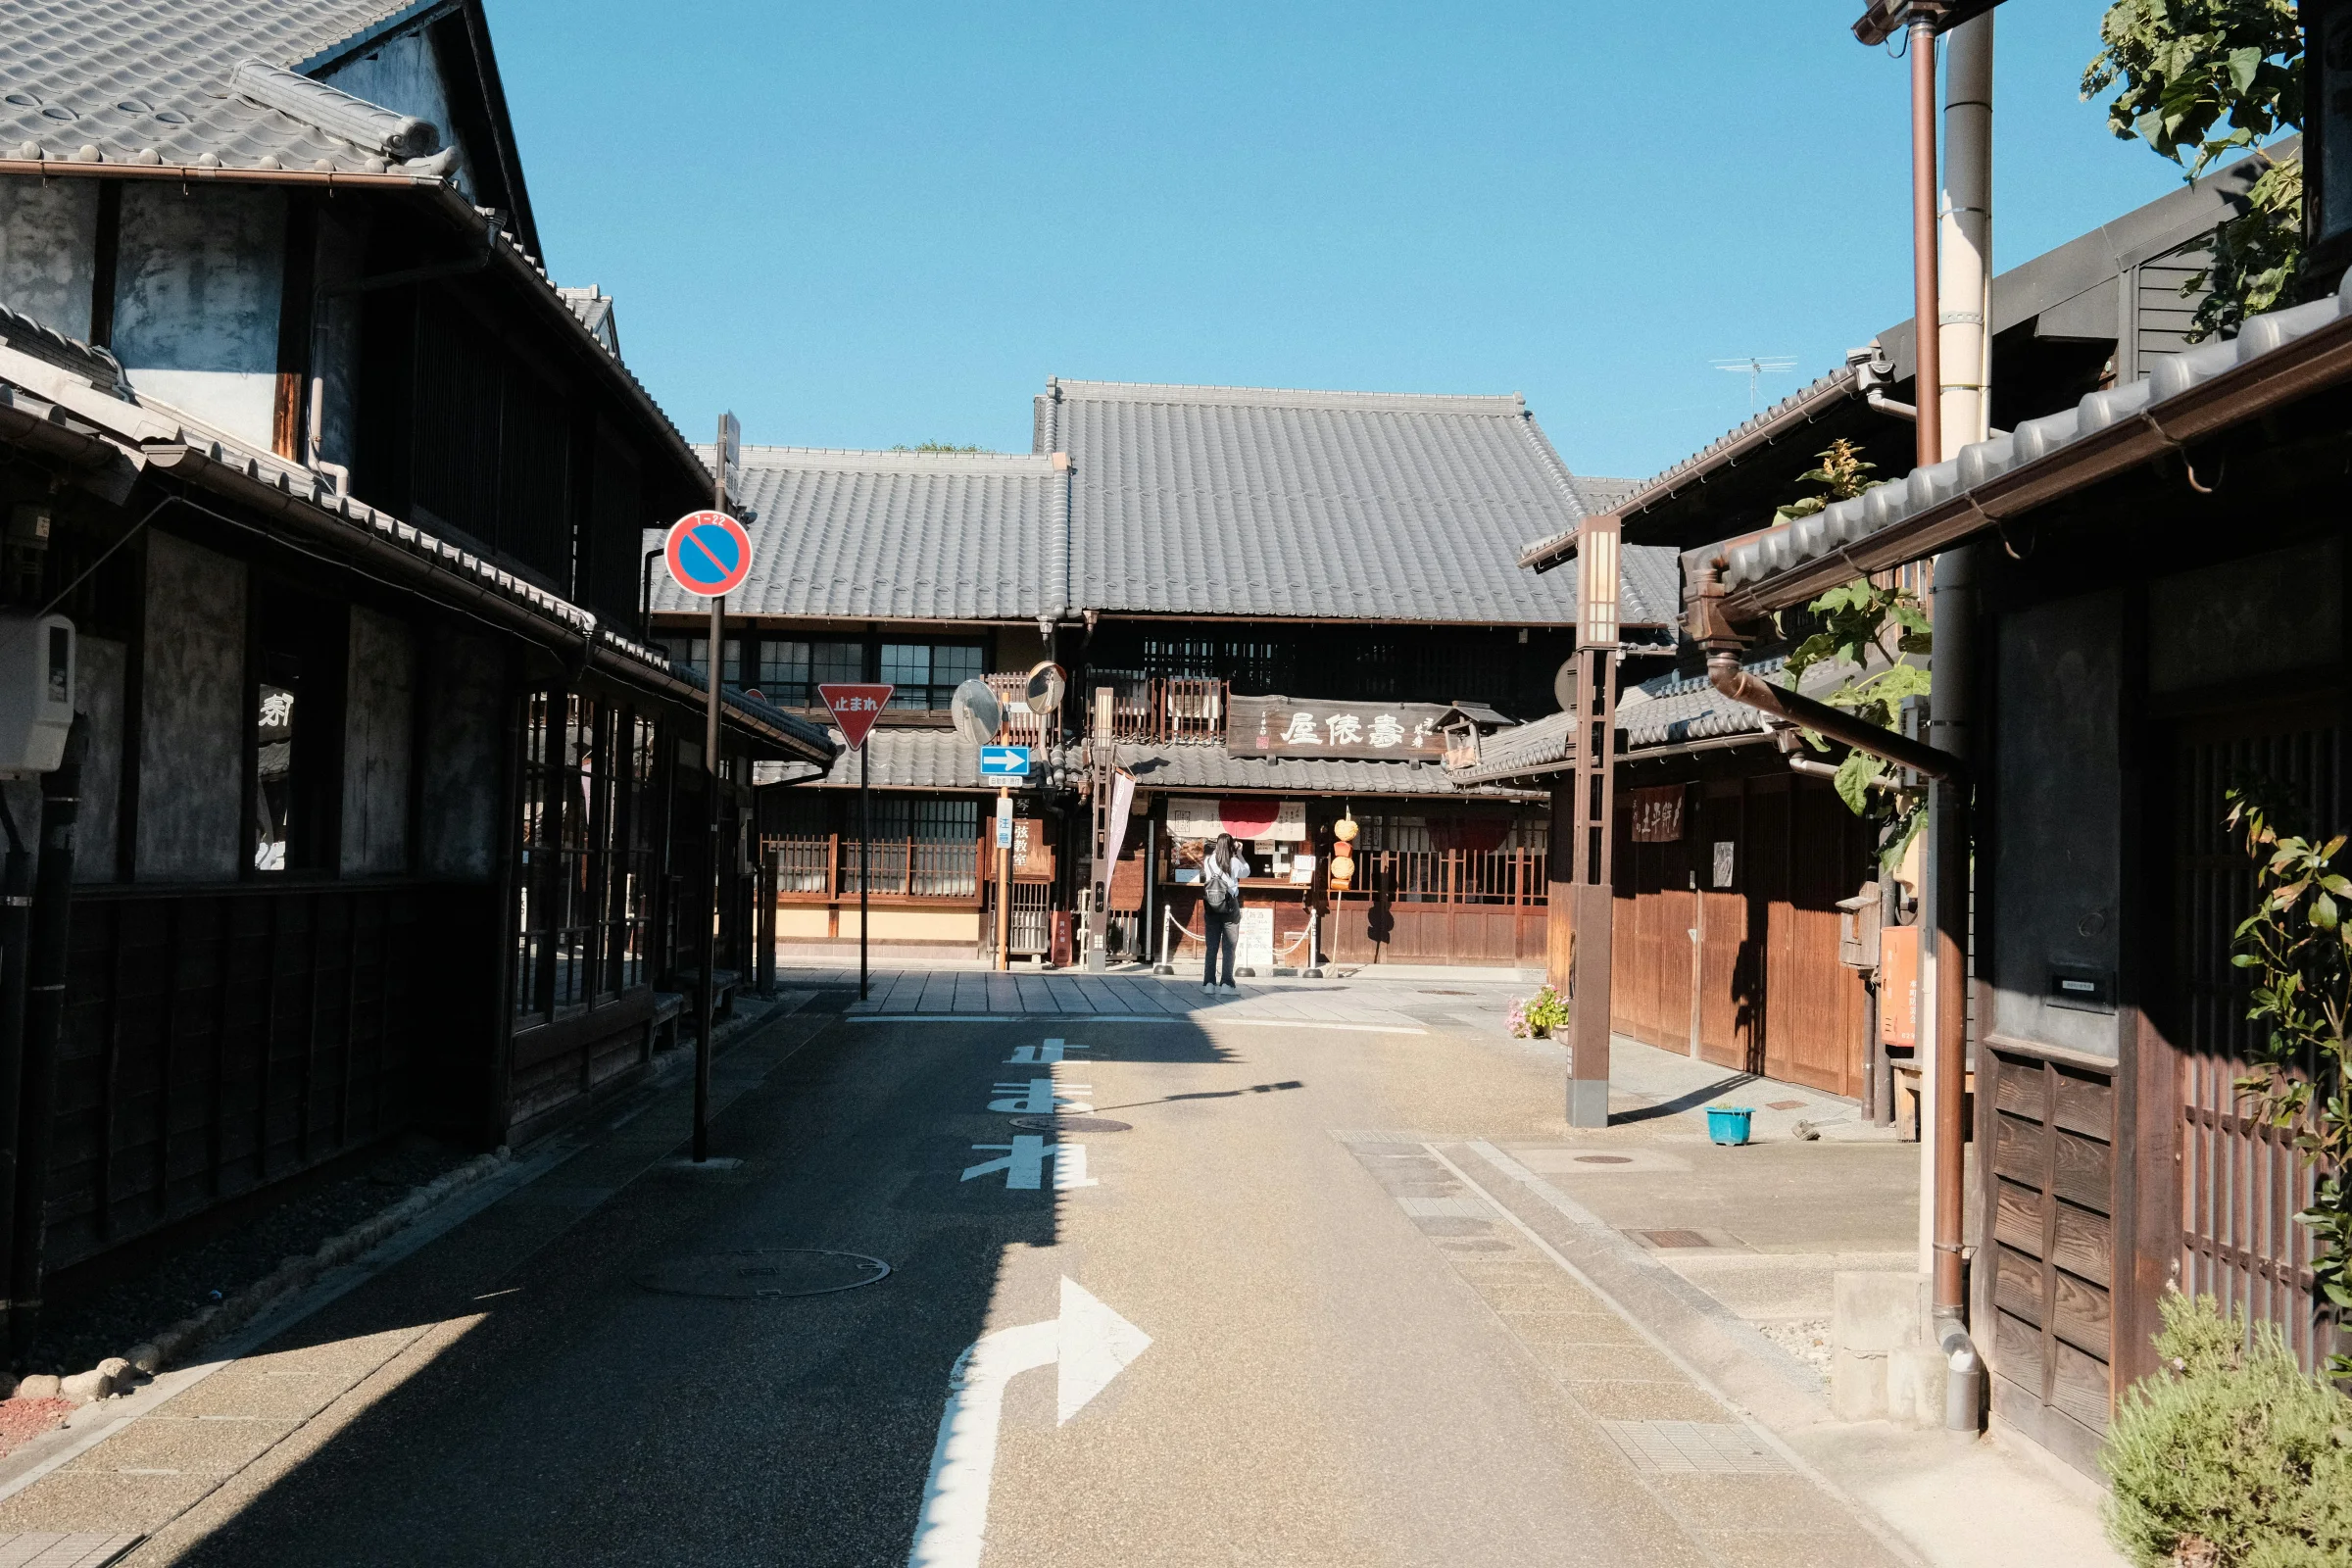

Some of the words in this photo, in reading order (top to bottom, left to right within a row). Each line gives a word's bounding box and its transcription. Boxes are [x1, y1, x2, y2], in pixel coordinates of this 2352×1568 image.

[694, 514, 726, 527] 7-22
[833, 696, 879, 711] 止まれ
[999, 817, 1010, 844] 注意
[960, 1038, 1100, 1190] 止まれ
